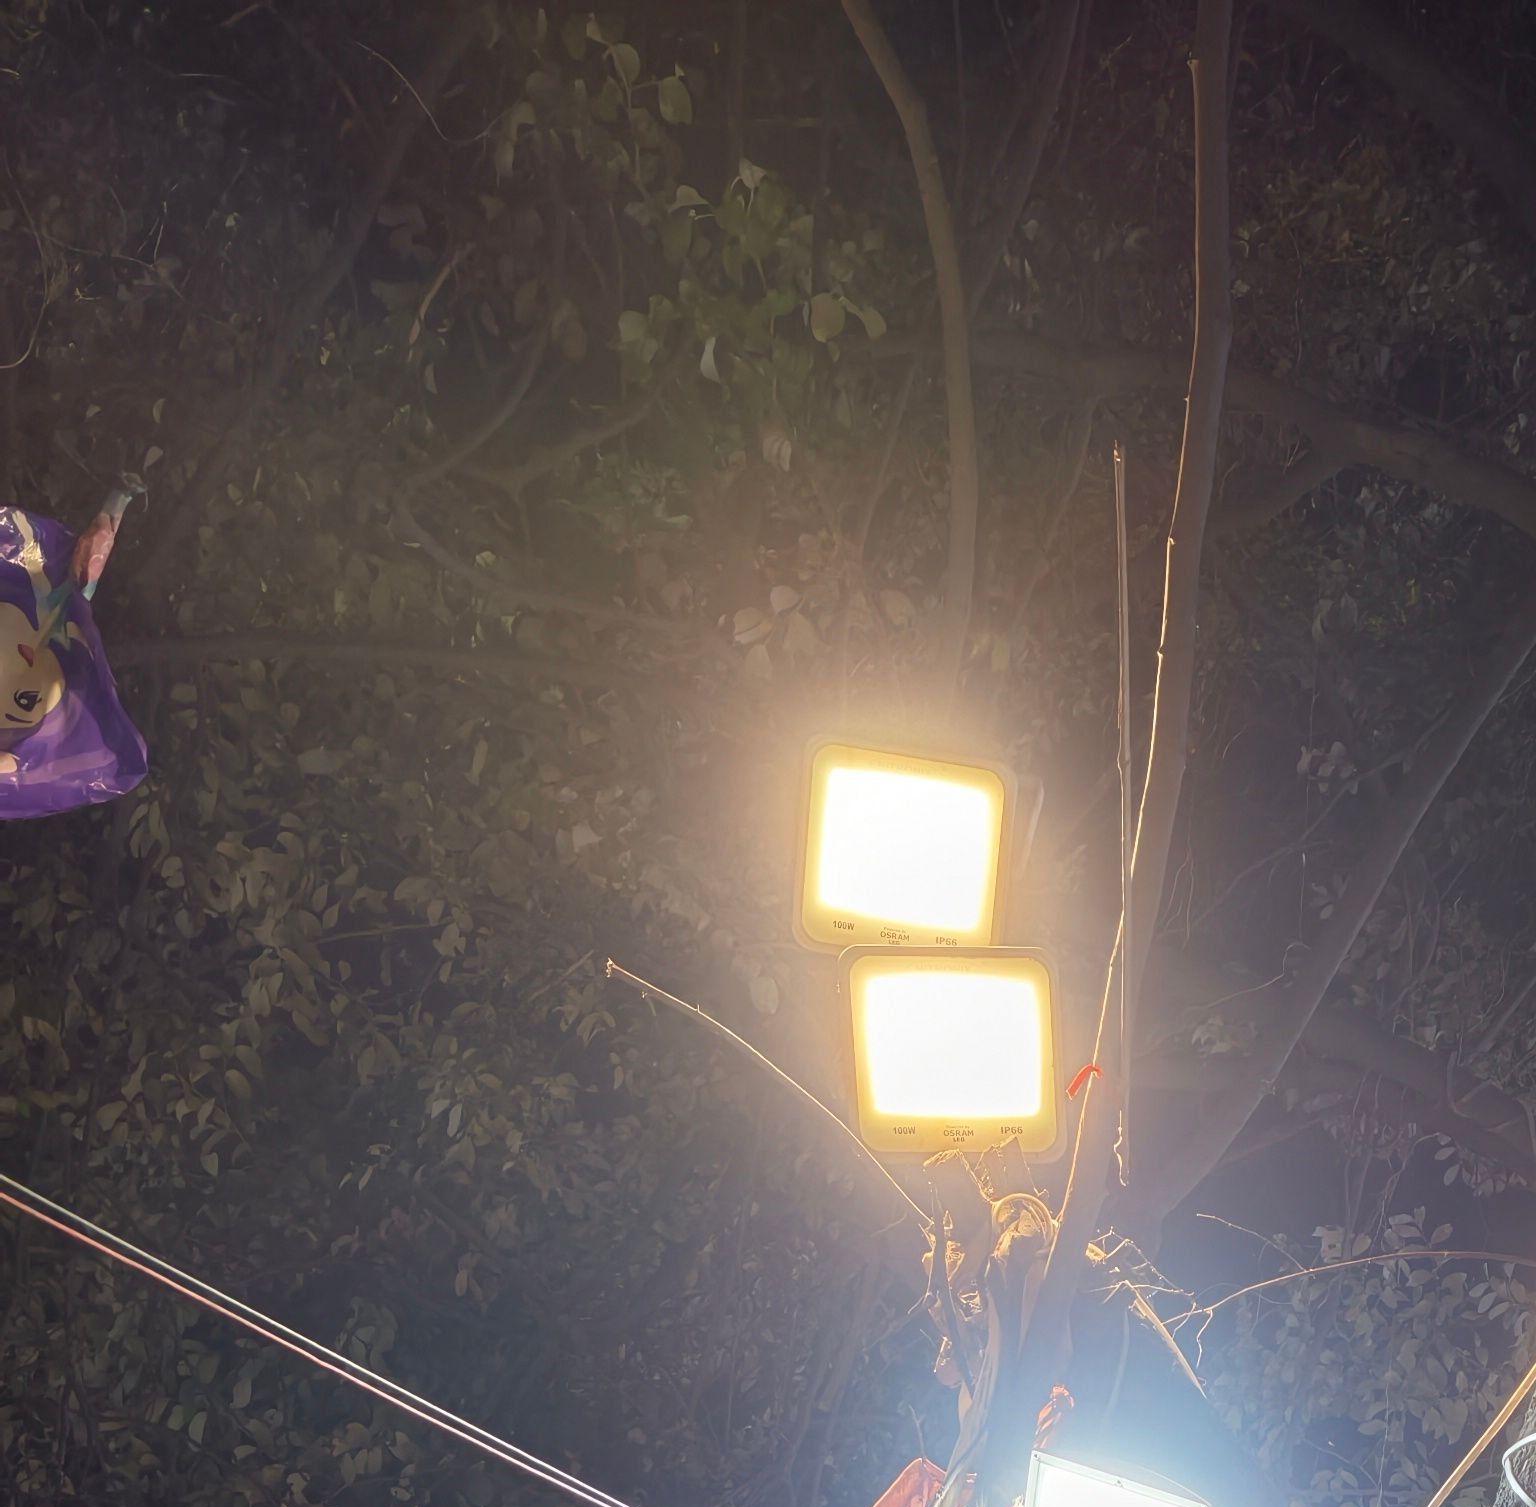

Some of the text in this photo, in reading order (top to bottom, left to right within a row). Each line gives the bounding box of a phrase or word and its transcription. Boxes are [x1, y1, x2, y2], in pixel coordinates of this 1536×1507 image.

[880, 930, 910, 942] OSRAM
[935, 936, 958, 947] IP66
[943, 1128, 974, 1138] OSRAM
